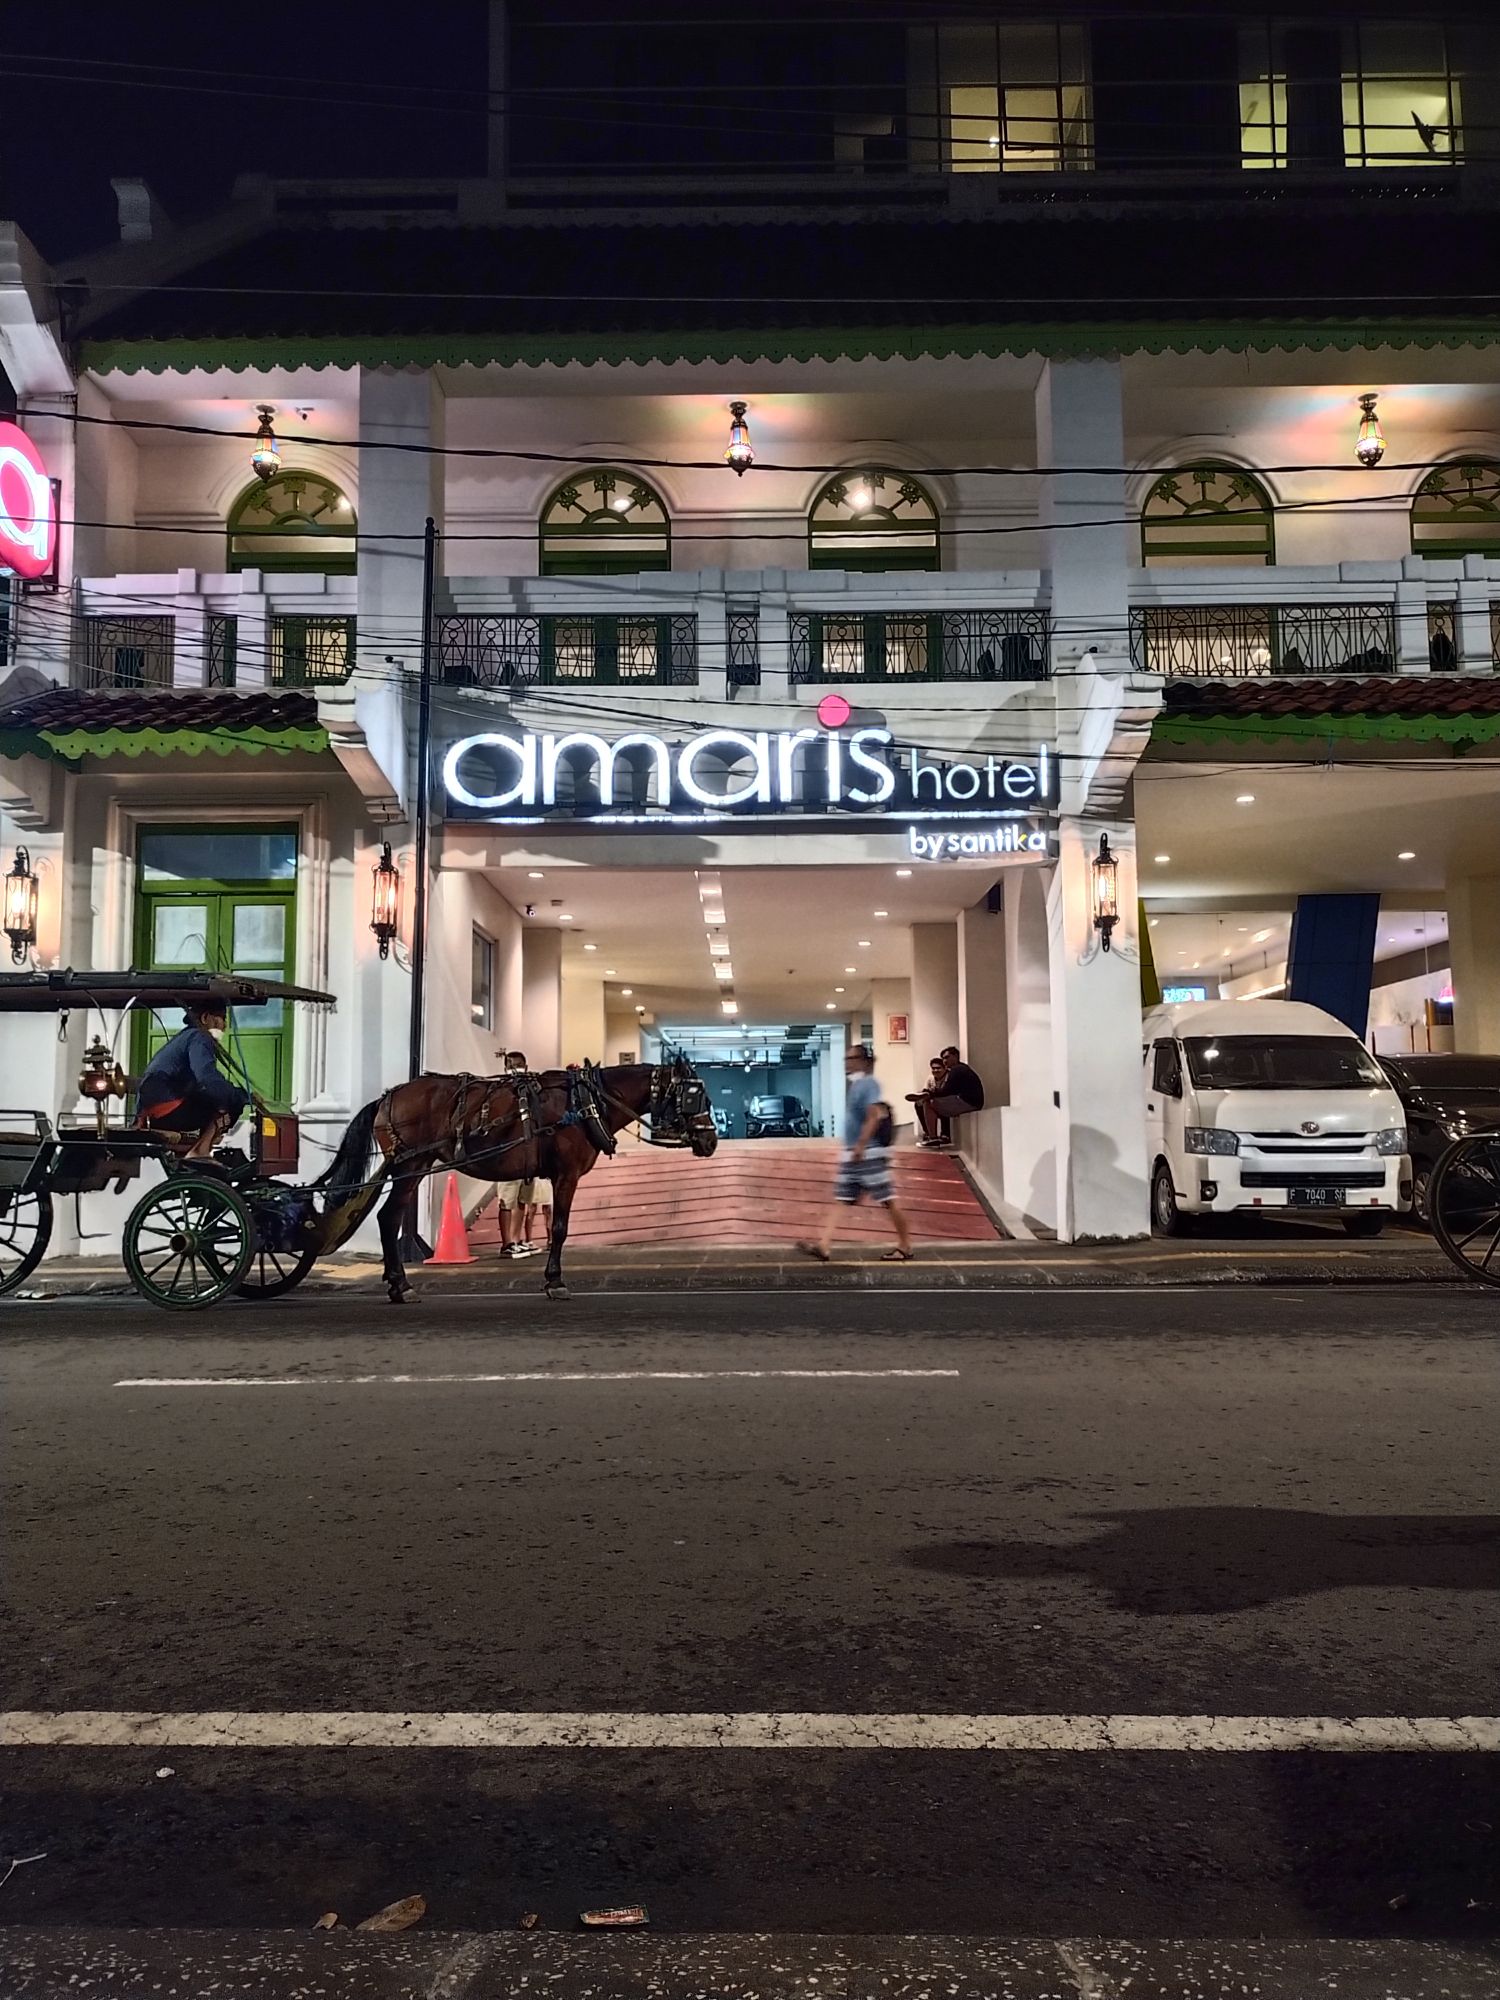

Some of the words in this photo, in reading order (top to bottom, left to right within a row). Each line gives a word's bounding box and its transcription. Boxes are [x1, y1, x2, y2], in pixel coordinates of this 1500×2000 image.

[443, 695, 896, 807] amaris
[911, 744, 1049, 799] hotel
[909, 826, 944, 859] by
[948, 824, 1047, 852] santika
